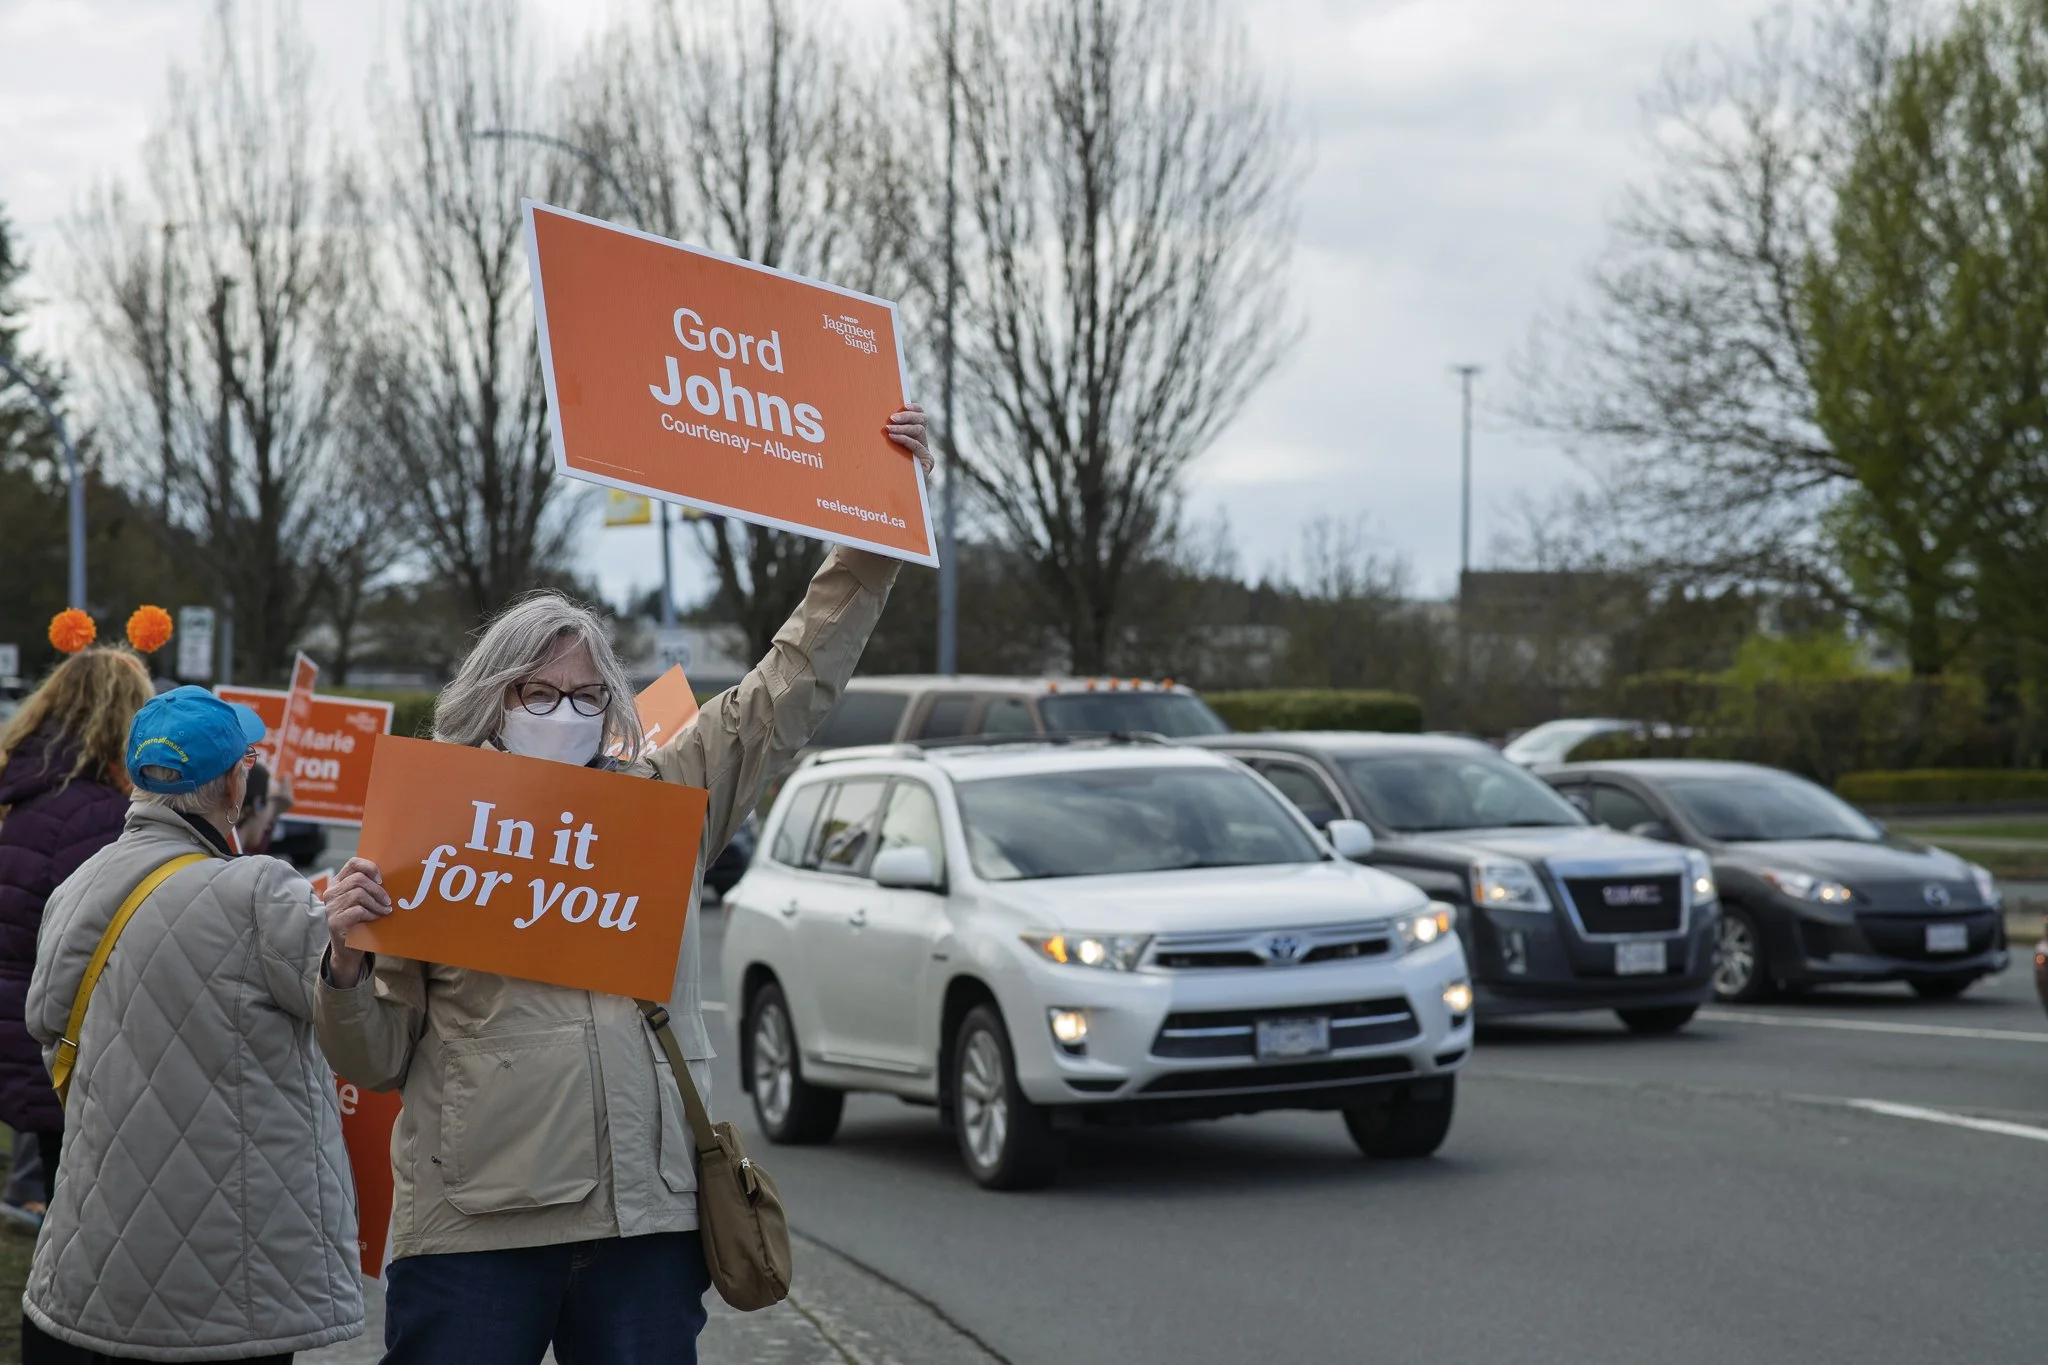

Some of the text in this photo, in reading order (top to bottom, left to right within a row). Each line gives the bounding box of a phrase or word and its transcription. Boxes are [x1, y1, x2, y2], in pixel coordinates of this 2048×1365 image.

[673, 307, 784, 374] Gord
[822, 313, 876, 341] Jagmeet
[844, 334, 878, 355] Singh
[649, 355, 826, 443] Johns
[816, 497, 906, 529] reelectgord.ca
[464, 800, 599, 870] In it
[397, 844, 640, 932] for you
